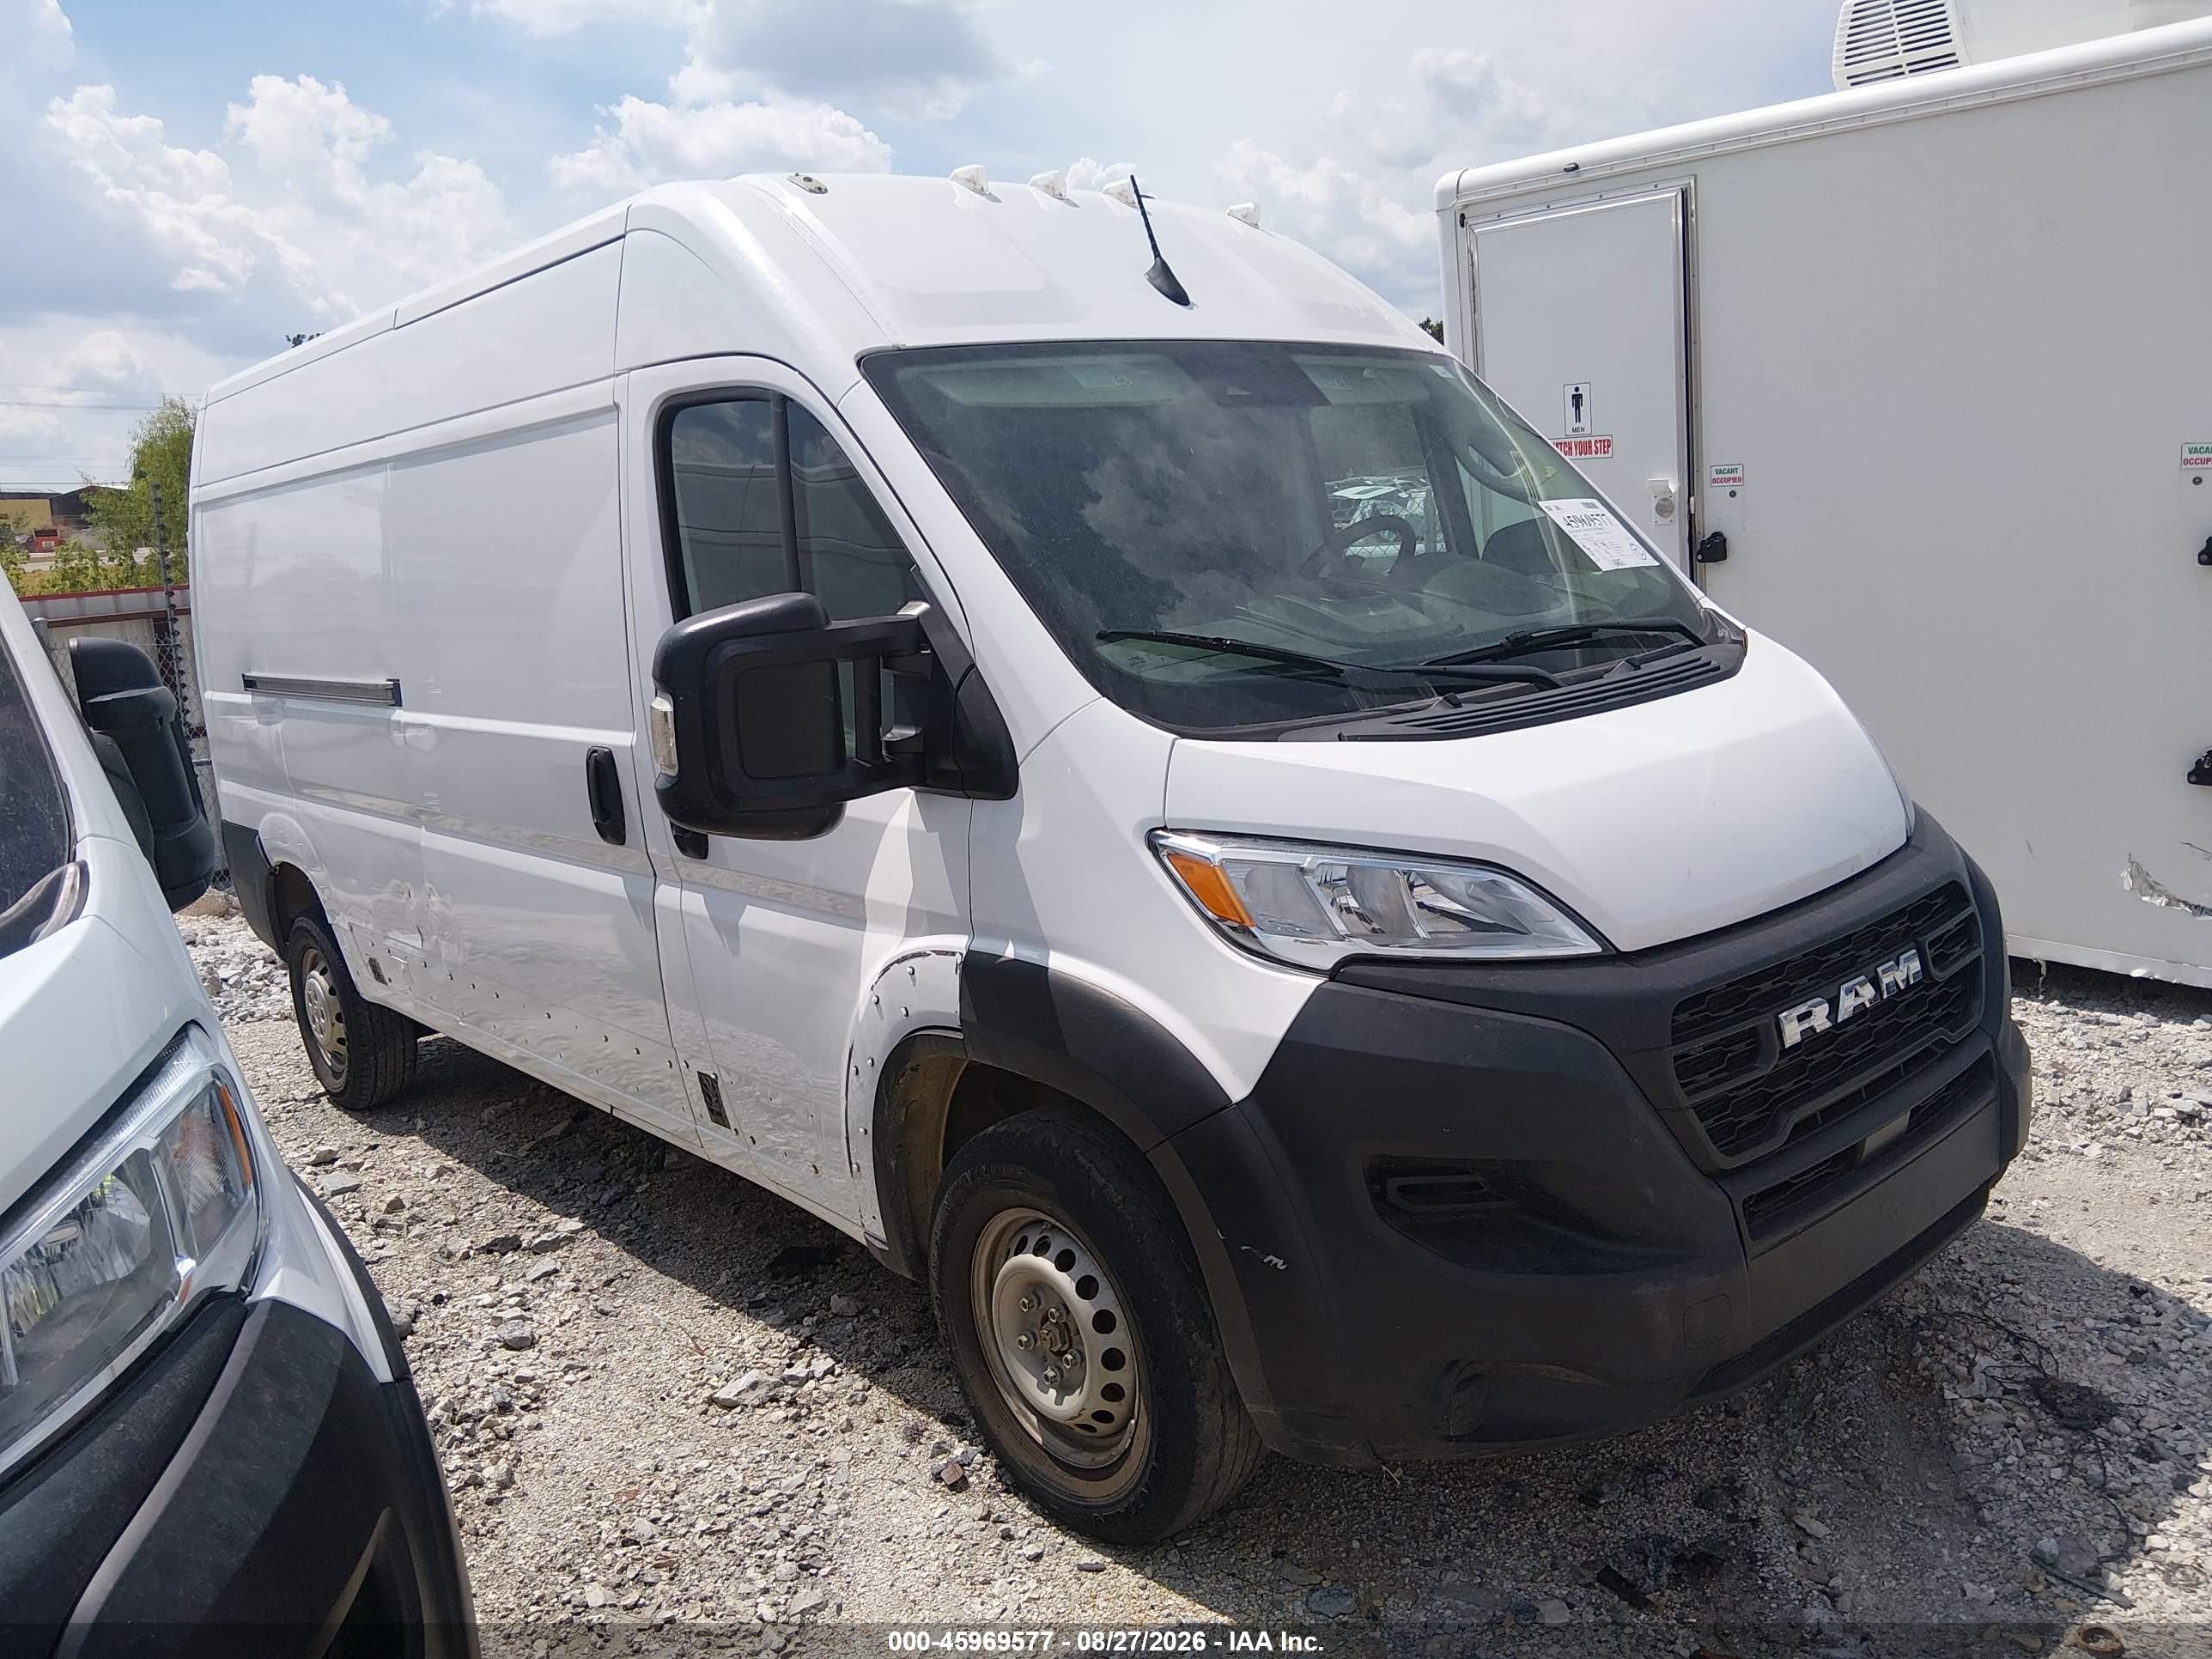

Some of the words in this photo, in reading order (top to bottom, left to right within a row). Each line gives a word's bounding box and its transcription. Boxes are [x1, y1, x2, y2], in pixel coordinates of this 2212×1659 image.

[1553, 441, 1572, 456] ATCH
[1574, 440, 1593, 456] YOUR
[1595, 439, 1611, 454] STEP
[1563, 514, 1613, 528] 45969577
[1778, 949, 1923, 1048] RAM
